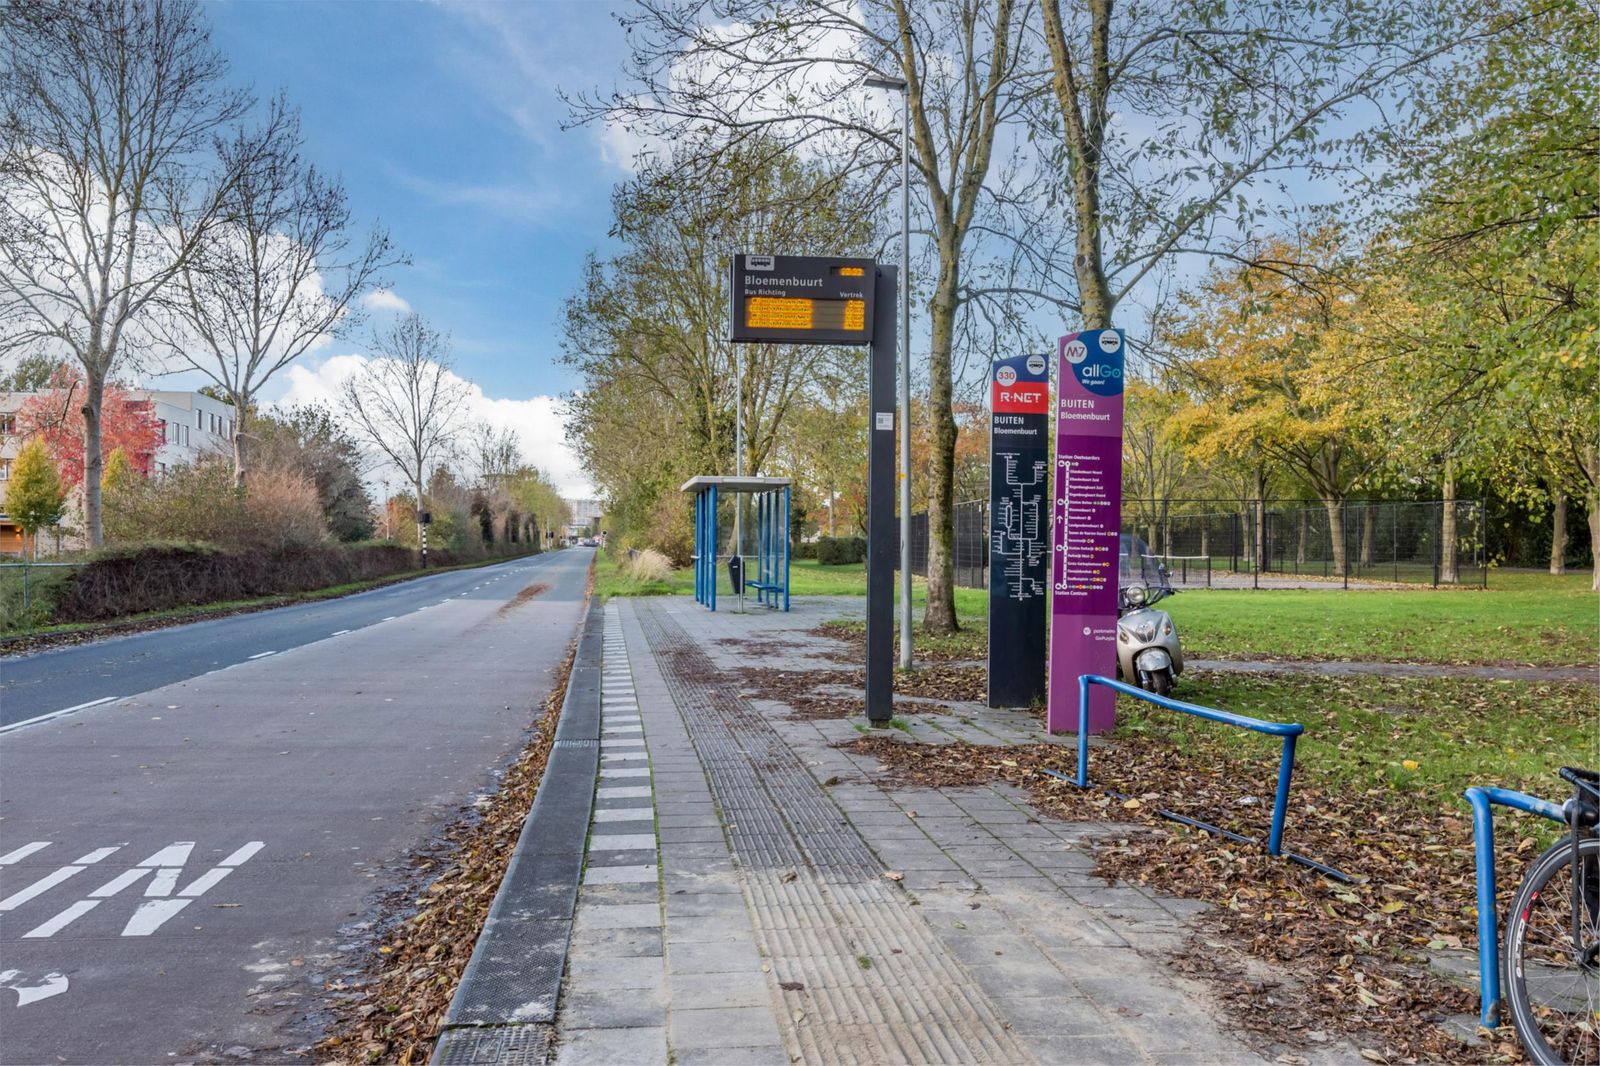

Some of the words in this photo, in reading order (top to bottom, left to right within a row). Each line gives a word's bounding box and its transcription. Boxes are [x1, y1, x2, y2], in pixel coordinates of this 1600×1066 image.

[744, 275, 823, 286] Bloemenbuurt
[1066, 346, 1085, 357] M7
[1082, 364, 1121, 378] allGo
[1061, 399, 1094, 408] BUITEN
[994, 416, 1024, 424] BUITEN
[1061, 412, 1110, 420] Bloemenbuurt
